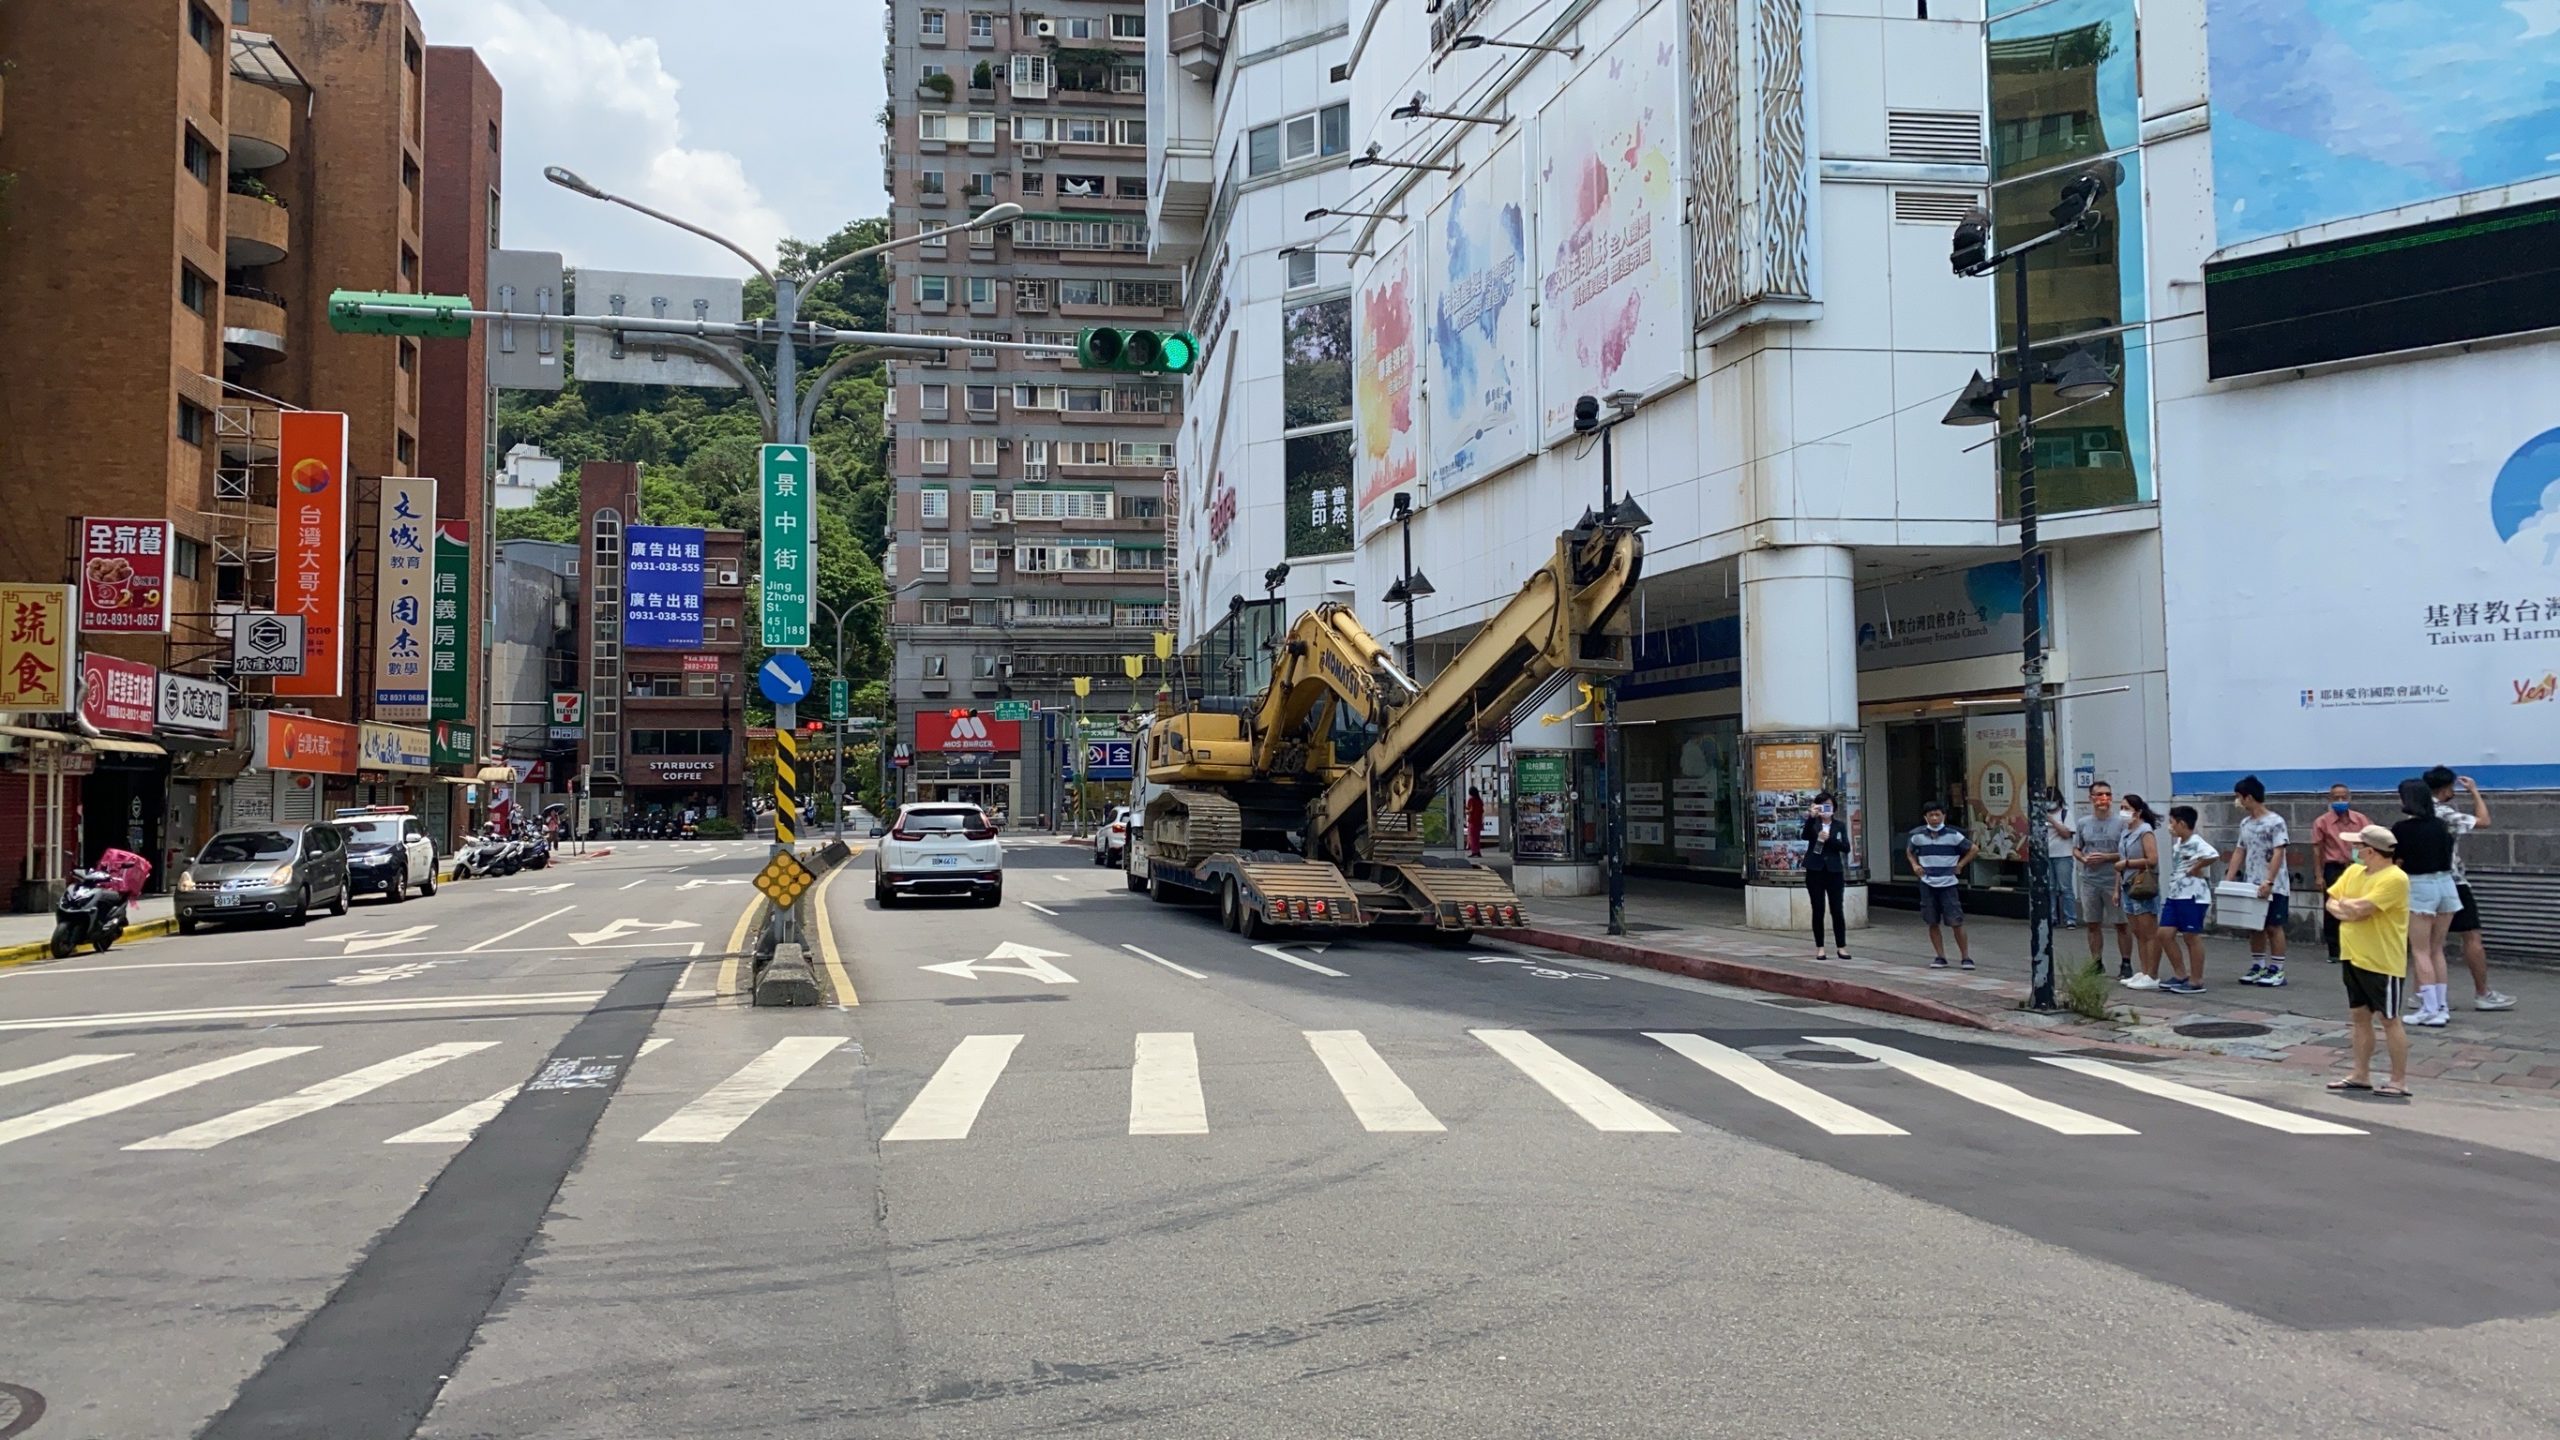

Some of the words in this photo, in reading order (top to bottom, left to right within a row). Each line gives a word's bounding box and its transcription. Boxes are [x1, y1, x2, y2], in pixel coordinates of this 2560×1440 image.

[1311, 489, 1327, 533] 無印。
[1332, 486, 1347, 530] 當然、
[389, 491, 424, 553] 文城
[774, 473, 798, 570] 景中街
[89, 524, 162, 555] 全家餐
[631, 542, 701, 558] 廣告出租
[297, 505, 322, 614] 台灣大哥大
[390, 556, 420, 569] 教育
[630, 561, 700, 572] 0931-038-555
[766, 581, 792, 593] Jing
[629, 592, 700, 609] 廣告出租
[766, 592, 805, 604] Zhong
[766, 602, 783, 612] St.
[96, 613, 160, 626] 02-8931-0857
[434, 573, 457, 671] 信義房屋
[629, 611, 700, 622] 0931-038-555
[388, 595, 420, 659] 周杰
[767, 616, 781, 626] 45
[786, 626, 805, 635] 188
[1935, 629, 1960, 643] Friends
[1961, 625, 1989, 639] Church
[767, 634, 780, 643] 33
[2426, 630, 2496, 646] Taiwan
[9, 601, 56, 695] 蔬食
[237, 657, 298, 672] 水產火鍋
[388, 663, 419, 676] 數學
[1325, 648, 1359, 700] KOMATSU
[2320, 683, 2449, 701] 耶穌愛你國際會議中心
[2512, 672, 2559, 704] Yes!
[182, 686, 222, 722] 水產火鍋
[297, 732, 331, 756] 台灣大哥大
[1112, 747, 1131, 762] 全
[650, 761, 714, 770] STARBUCKS
[662, 772, 702, 780] COFFEE
[2080, 774, 2092, 784] 36
